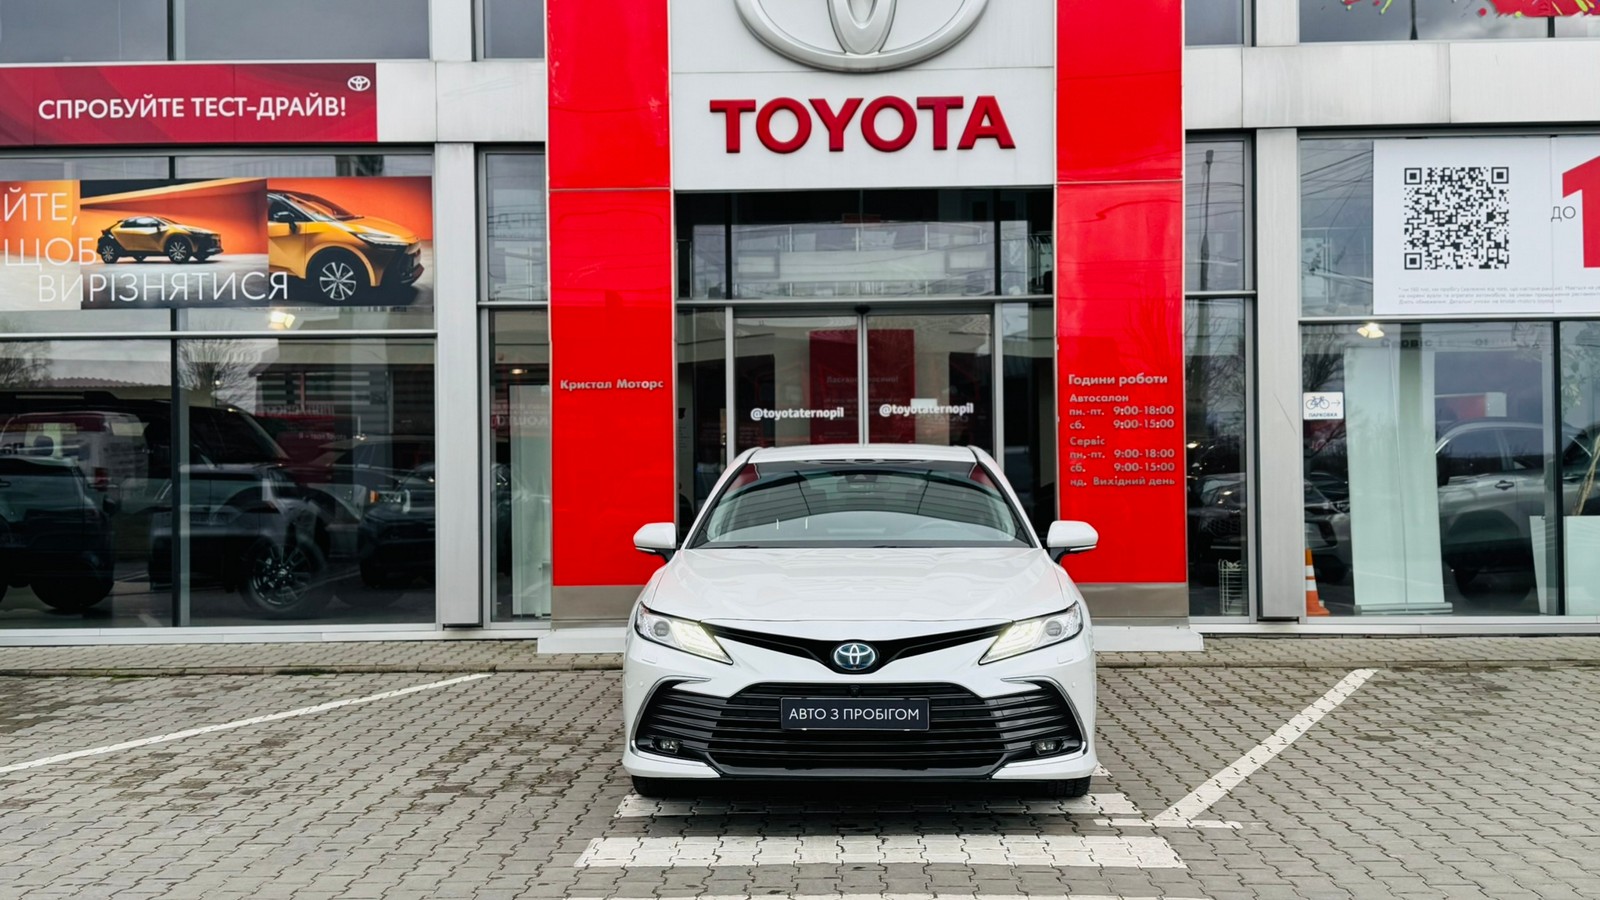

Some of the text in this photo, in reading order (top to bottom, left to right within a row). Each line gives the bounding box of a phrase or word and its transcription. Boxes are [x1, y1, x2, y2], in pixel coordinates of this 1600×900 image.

[38, 92, 346, 120] СПРОБУЙТЕ ТЕСТ-ДРАЙВ!
[709, 95, 1017, 154] TOYOTA
[1551, 206, 1576, 222] ДО
[4, 237, 97, 272] ЩОБ
[38, 271, 289, 302] ВИРІЗНЯТИСЯ
[560, 378, 664, 391] Кристал Моторс
[1068, 372, 1168, 387] Години роботи
[1069, 393, 1130, 403] Автосалон
[750, 407, 845, 421] @toyotaternopil
[879, 403, 975, 417] @toyotaternopil
[1069, 405, 1175, 416] пн.-пт. 9:00-18:00
[1069, 419, 1175, 430] сб. 9:00-15:00
[1069, 435, 1106, 448] Сервіс
[1069, 449, 1175, 459] пн.-пт. 9:00-18:00
[1070, 462, 1175, 473] сб. 9:00-15:00
[1070, 475, 1176, 487] нд. Вихідний день
[788, 708, 920, 720] АВТО З ПРОБІГОМ
